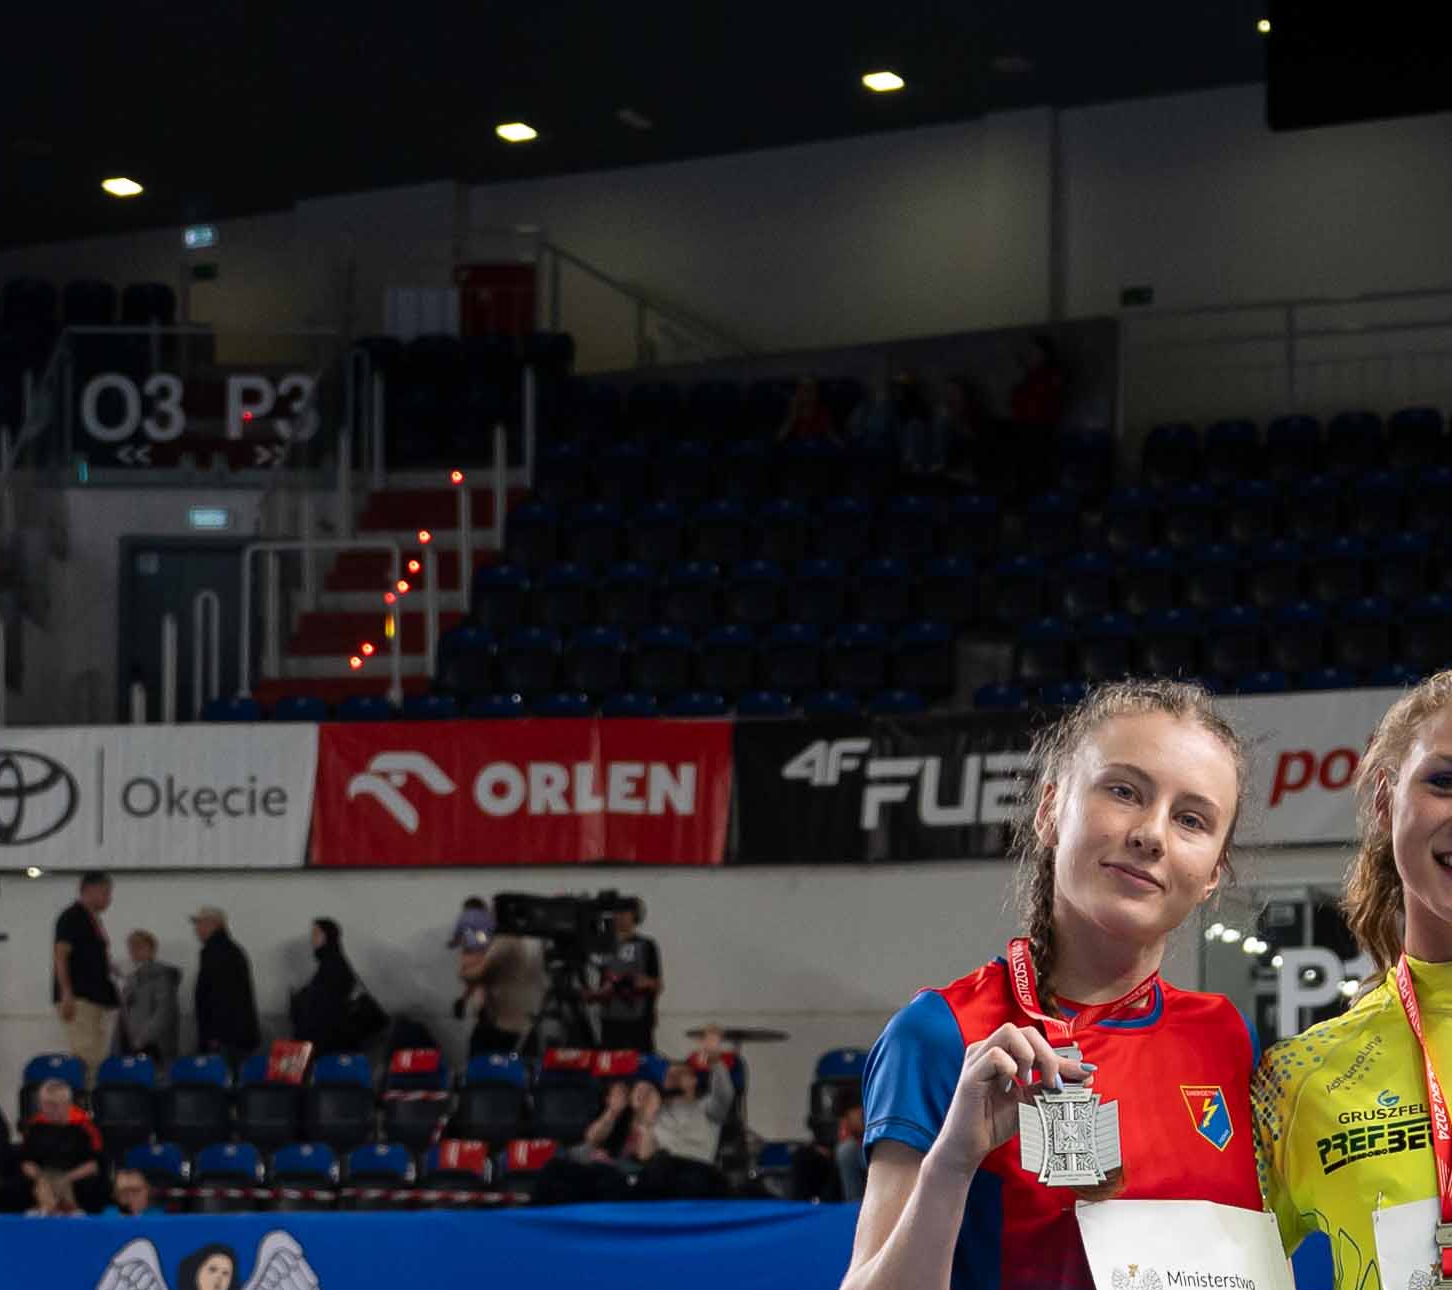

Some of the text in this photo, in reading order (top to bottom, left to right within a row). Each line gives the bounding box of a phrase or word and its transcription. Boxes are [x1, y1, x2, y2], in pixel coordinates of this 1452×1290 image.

[81, 374, 320, 441] O3 P3
[472, 762, 696, 816] ORLEN
[782, 738, 871, 787] 4F
[121, 775, 288, 828] Okęcie
[862, 753, 1035, 830] FUE
[1338, 1103, 1429, 1125] GRUSZFEL
[1316, 1122, 1435, 1166] PREFBE
